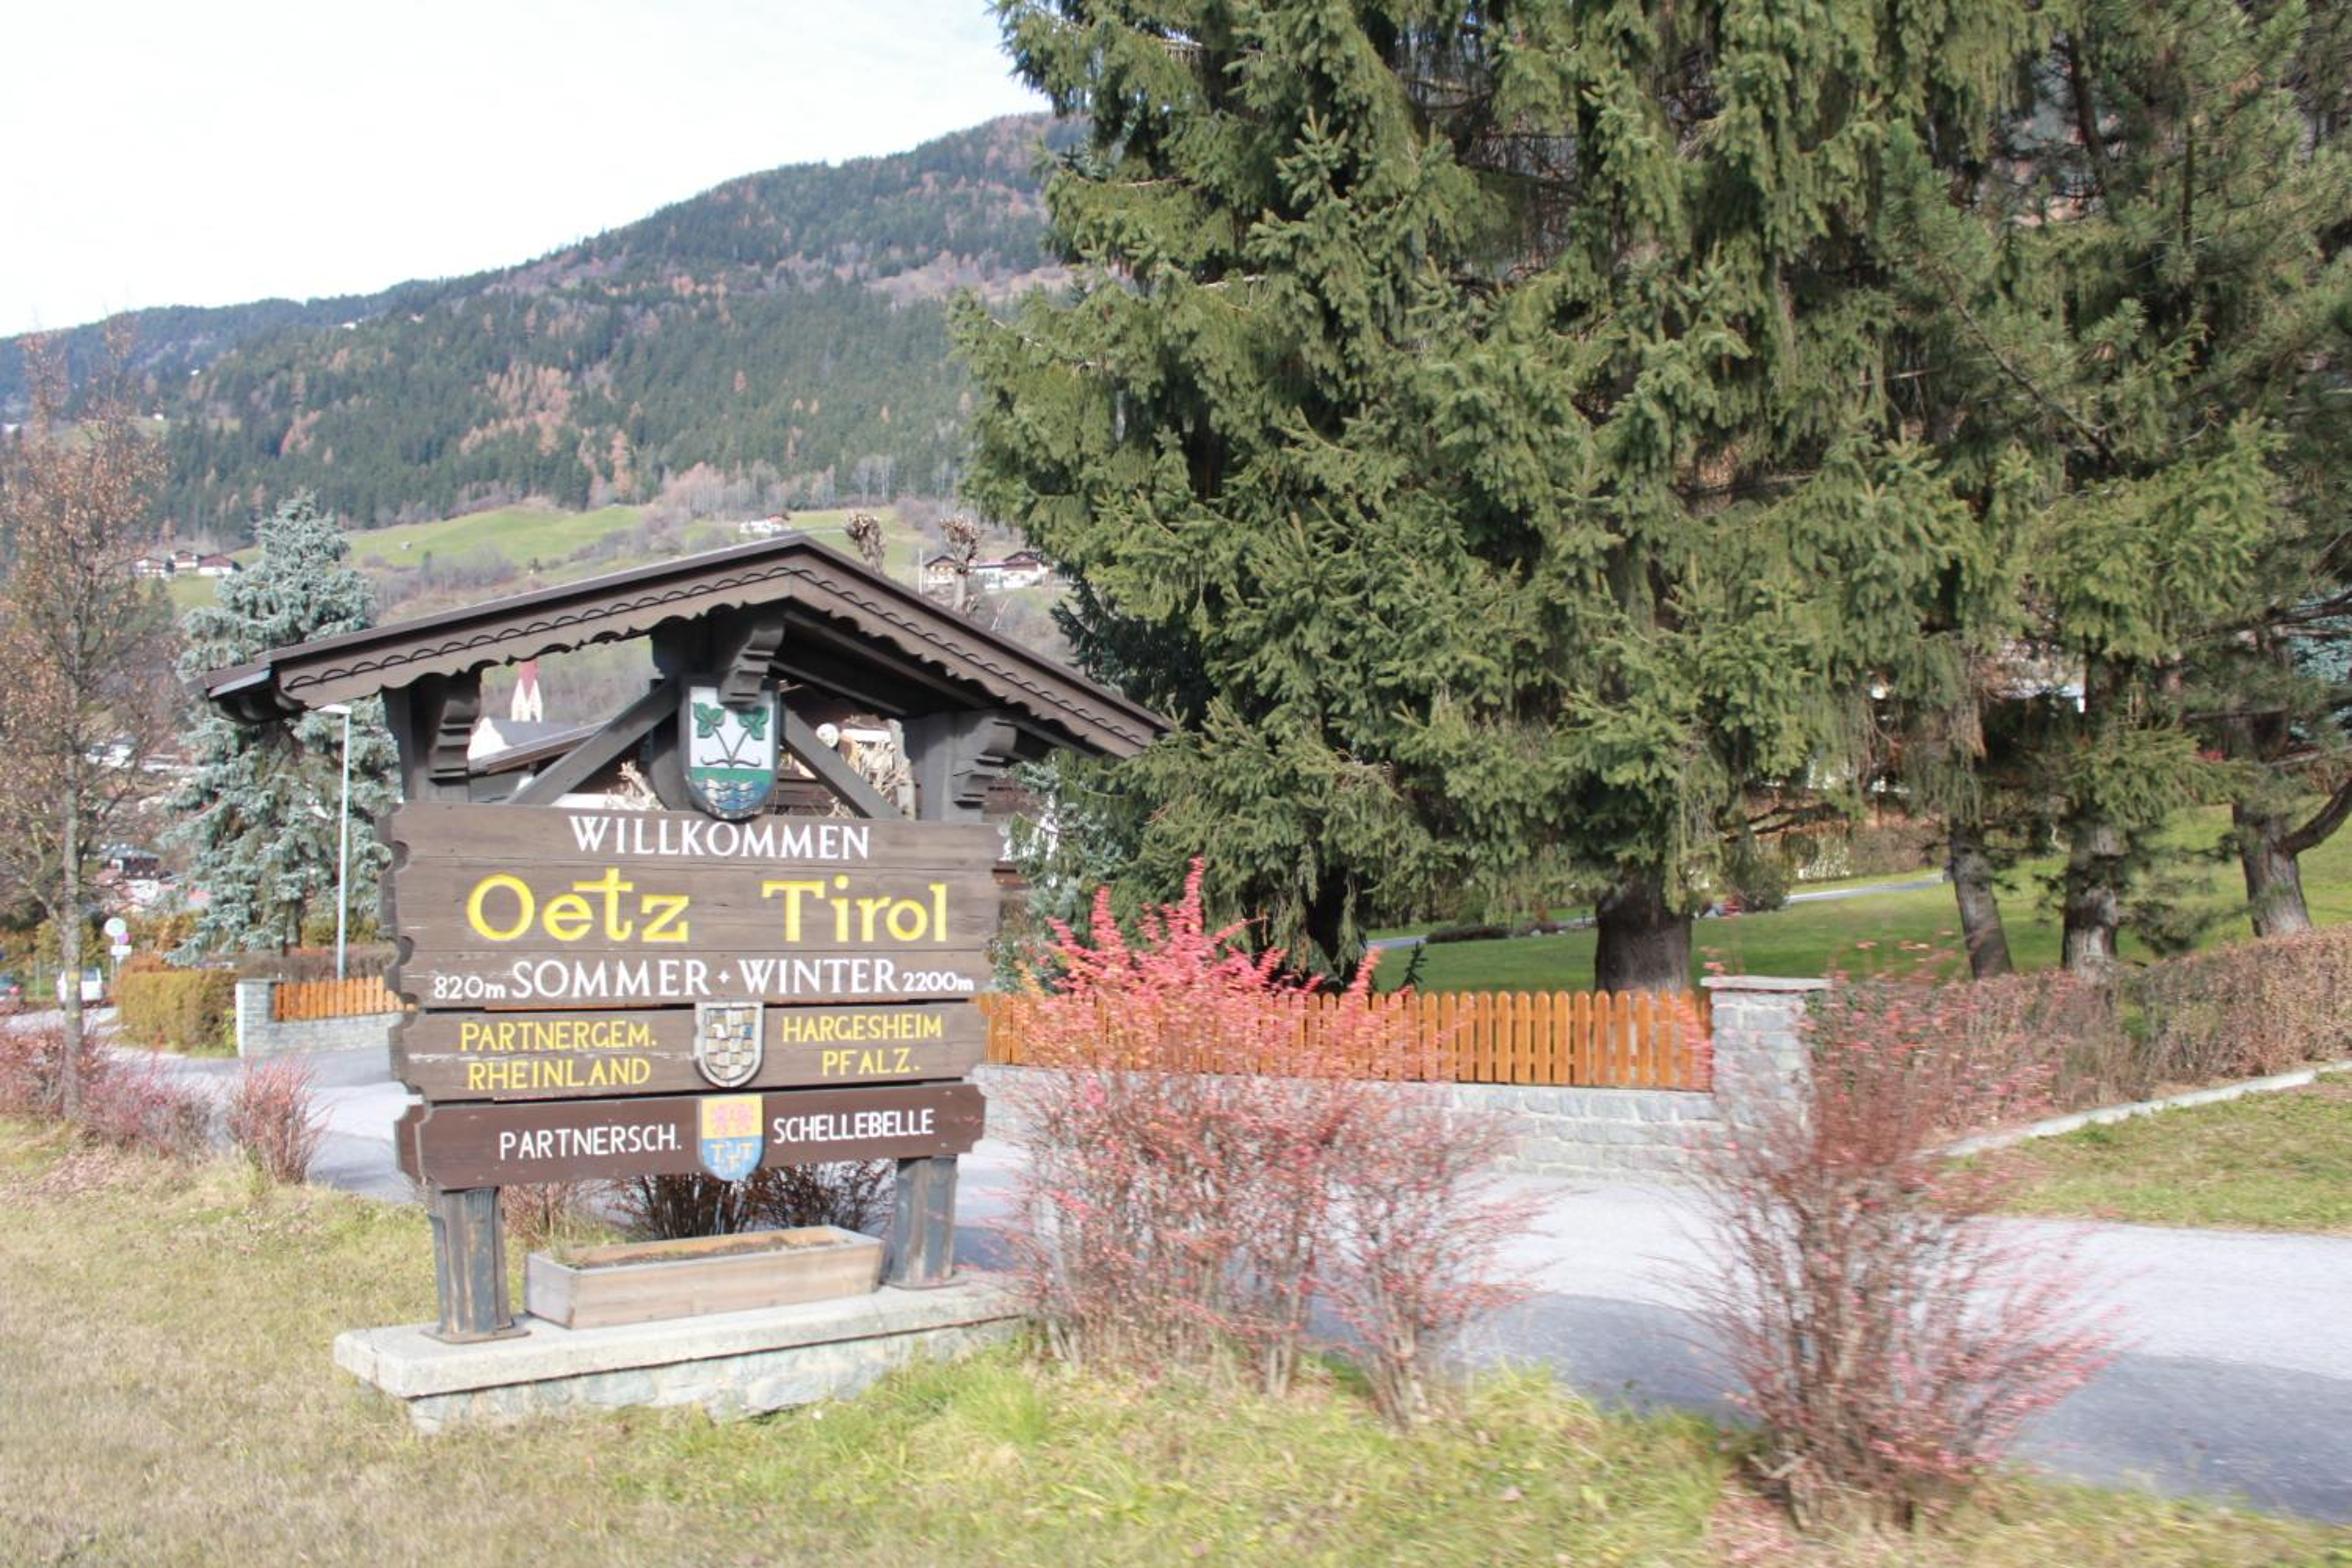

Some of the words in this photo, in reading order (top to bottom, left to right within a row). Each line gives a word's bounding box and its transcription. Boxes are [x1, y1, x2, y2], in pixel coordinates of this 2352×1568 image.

[569, 815, 870, 860] WILLKOMMEN
[466, 867, 690, 942] Oetz
[761, 873, 948, 942] Tirol
[433, 975, 507, 1000] 820m
[511, 959, 711, 998] SOMMER
[738, 958, 898, 993] WINTER
[902, 971, 975, 992] 2200m
[460, 1020, 658, 1052] PARTNERGEM.
[783, 1014, 943, 1043] HARGESHEIM
[468, 1056, 652, 1091] RHEINLAND
[822, 1048, 921, 1077] PFALZ.
[500, 1124, 683, 1161] PARTNERSCH.
[773, 1108, 935, 1144] SCHELLEBELLE
